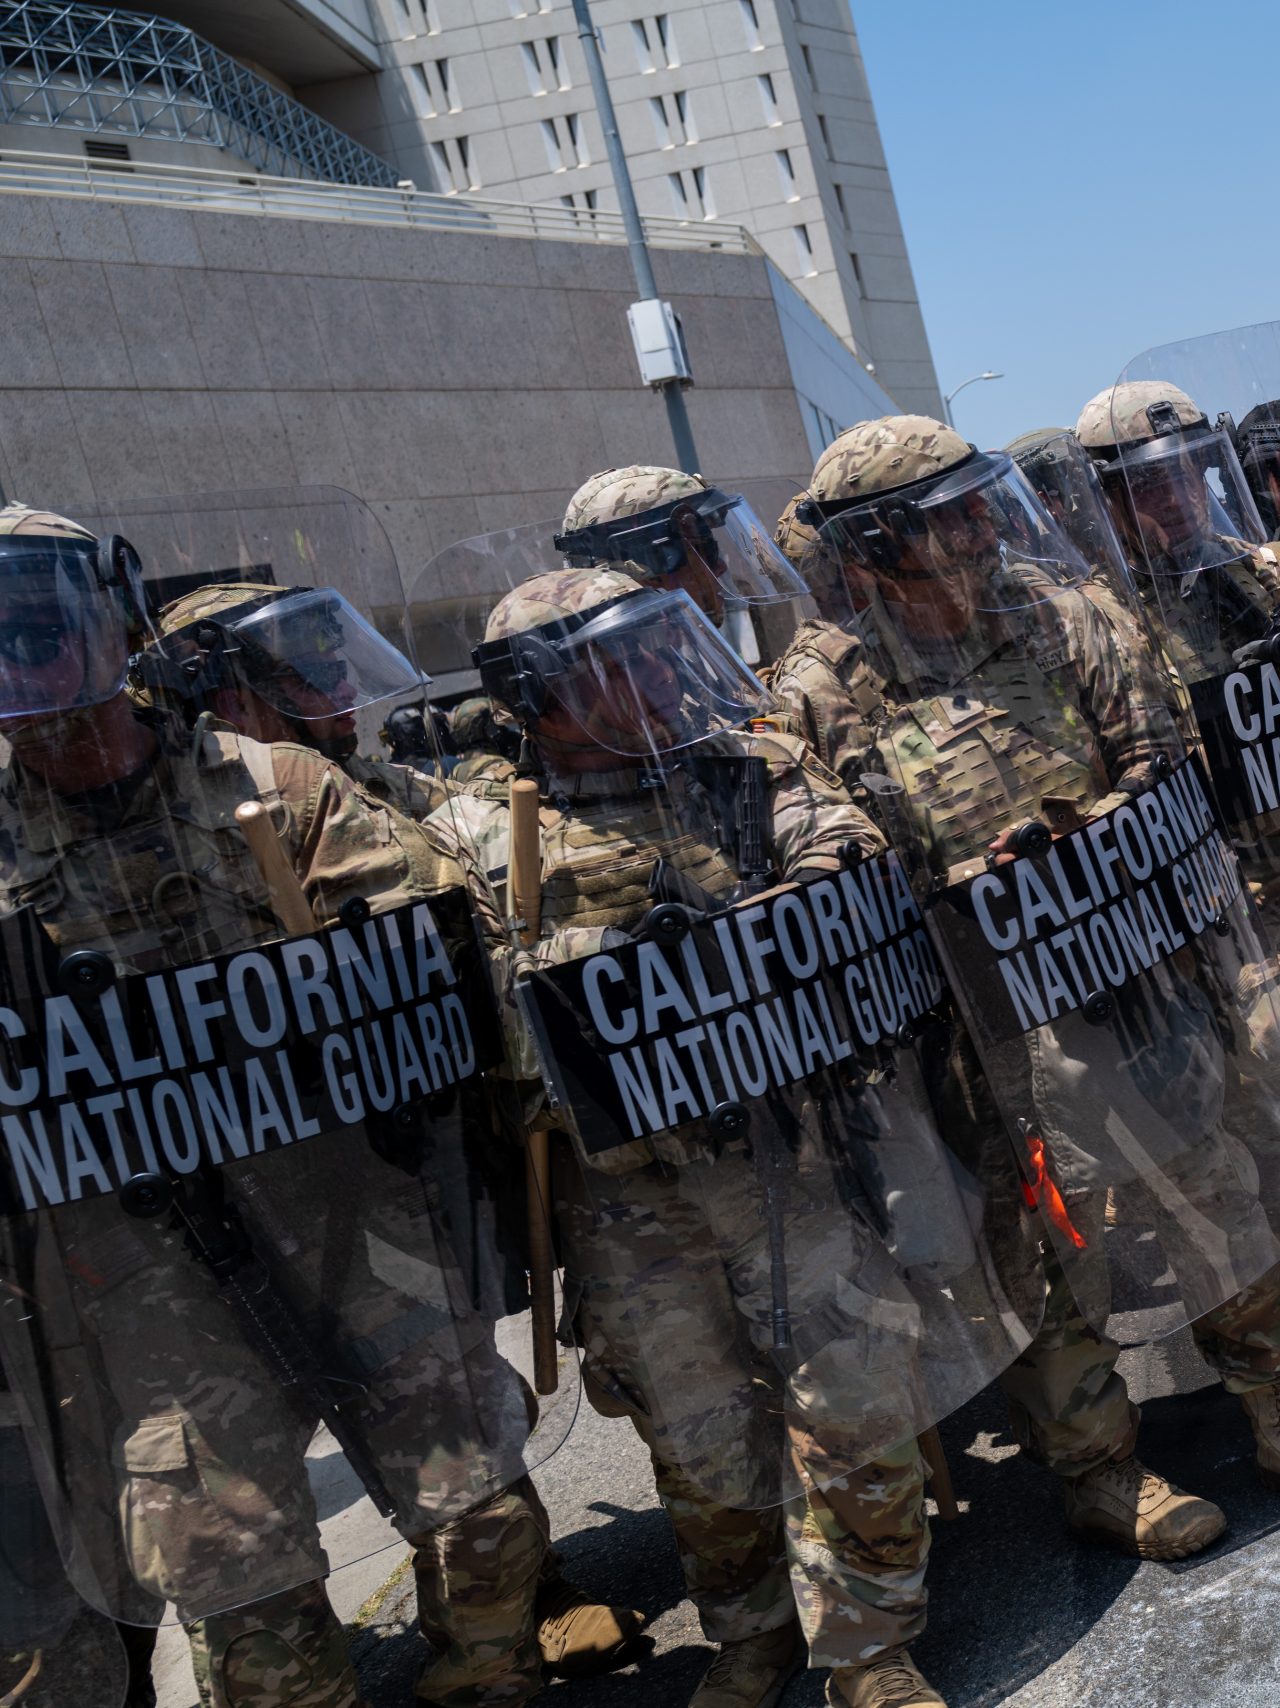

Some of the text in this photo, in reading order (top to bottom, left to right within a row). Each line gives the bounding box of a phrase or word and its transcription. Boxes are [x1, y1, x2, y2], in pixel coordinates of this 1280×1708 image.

[582, 849, 922, 1045] CALIFORNIA
[970, 761, 1215, 951] CALIFORNIA
[997, 880, 1186, 1031] NATIONAL
[0, 903, 458, 1107] CALIFORNIA
[2, 993, 476, 1210] NATIONAL GUARD
[608, 929, 941, 1138] NATIONAL GUARD
